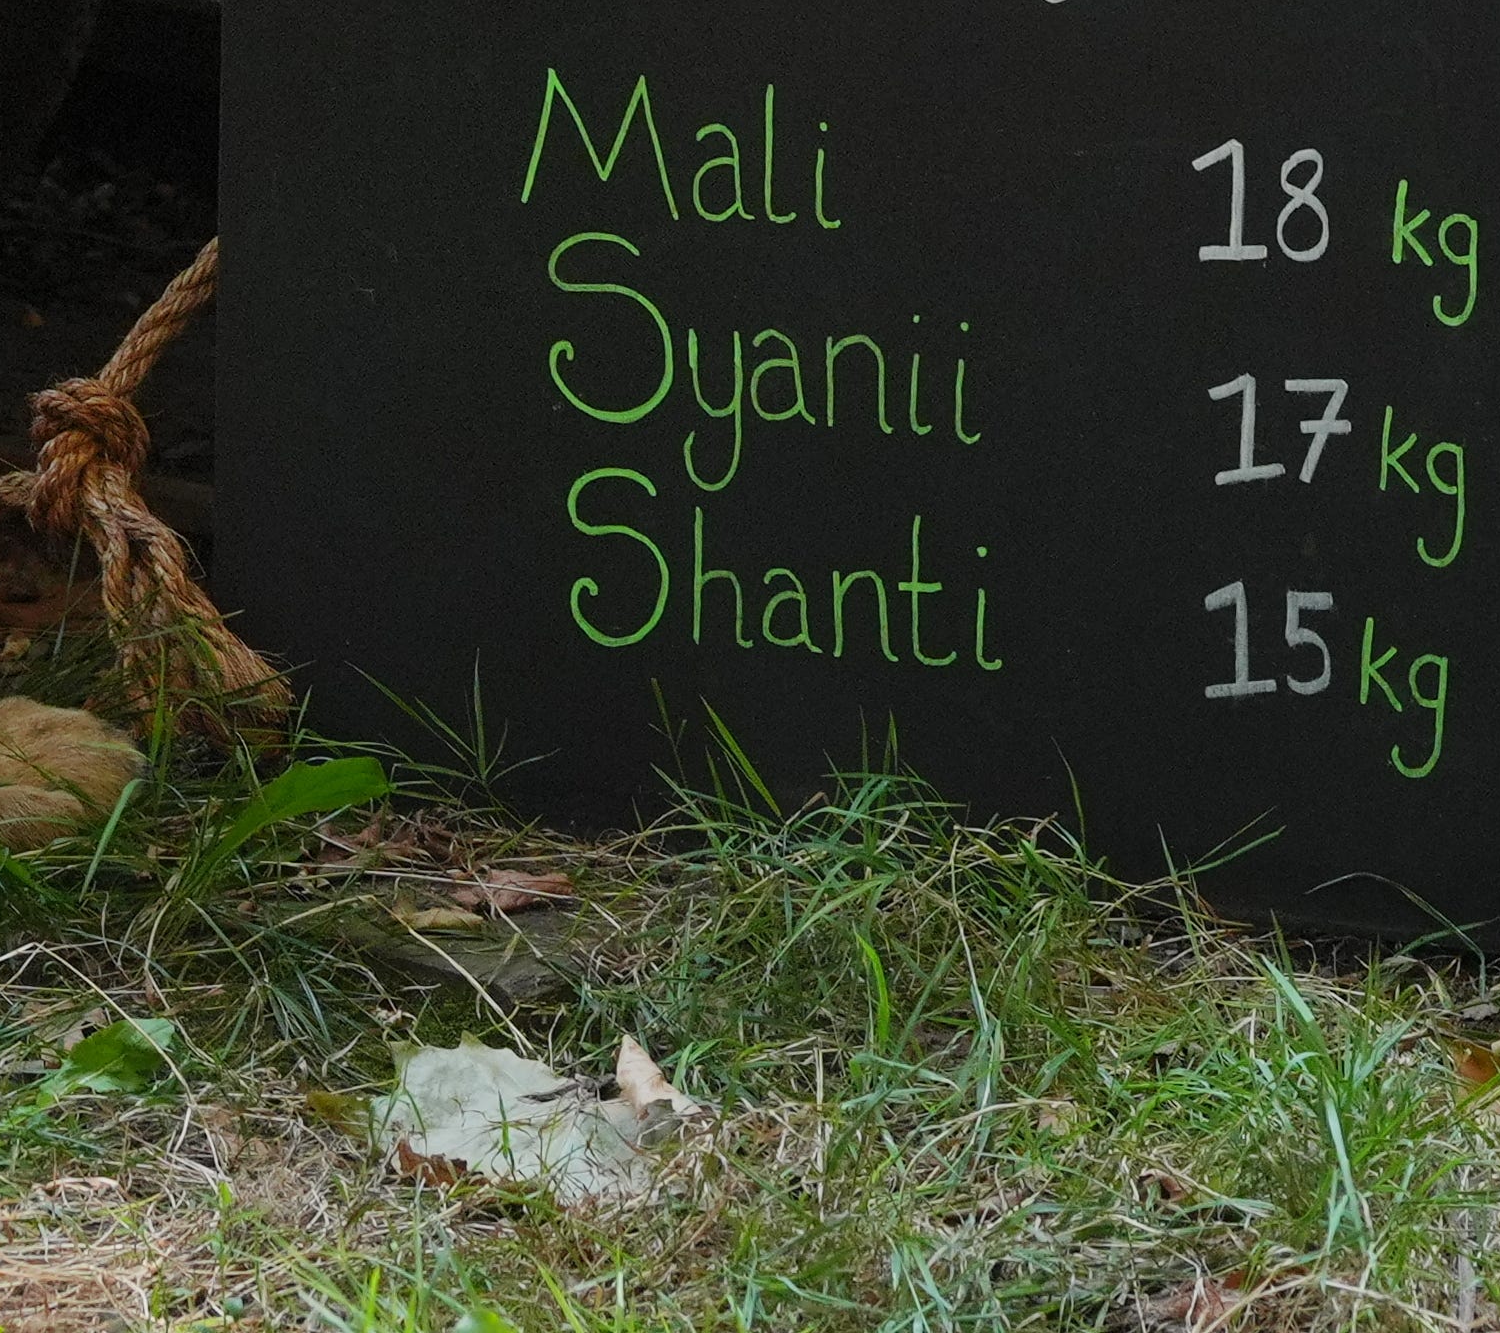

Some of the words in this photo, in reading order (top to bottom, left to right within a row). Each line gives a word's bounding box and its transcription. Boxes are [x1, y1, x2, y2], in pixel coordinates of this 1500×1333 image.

[519, 66, 842, 230] Mali
[1190, 137, 1331, 263] 18
[1390, 178, 1479, 328] kg
[547, 231, 982, 492] Syanii
[1206, 371, 1353, 487] 17
[566, 466, 1004, 672] Shanti
